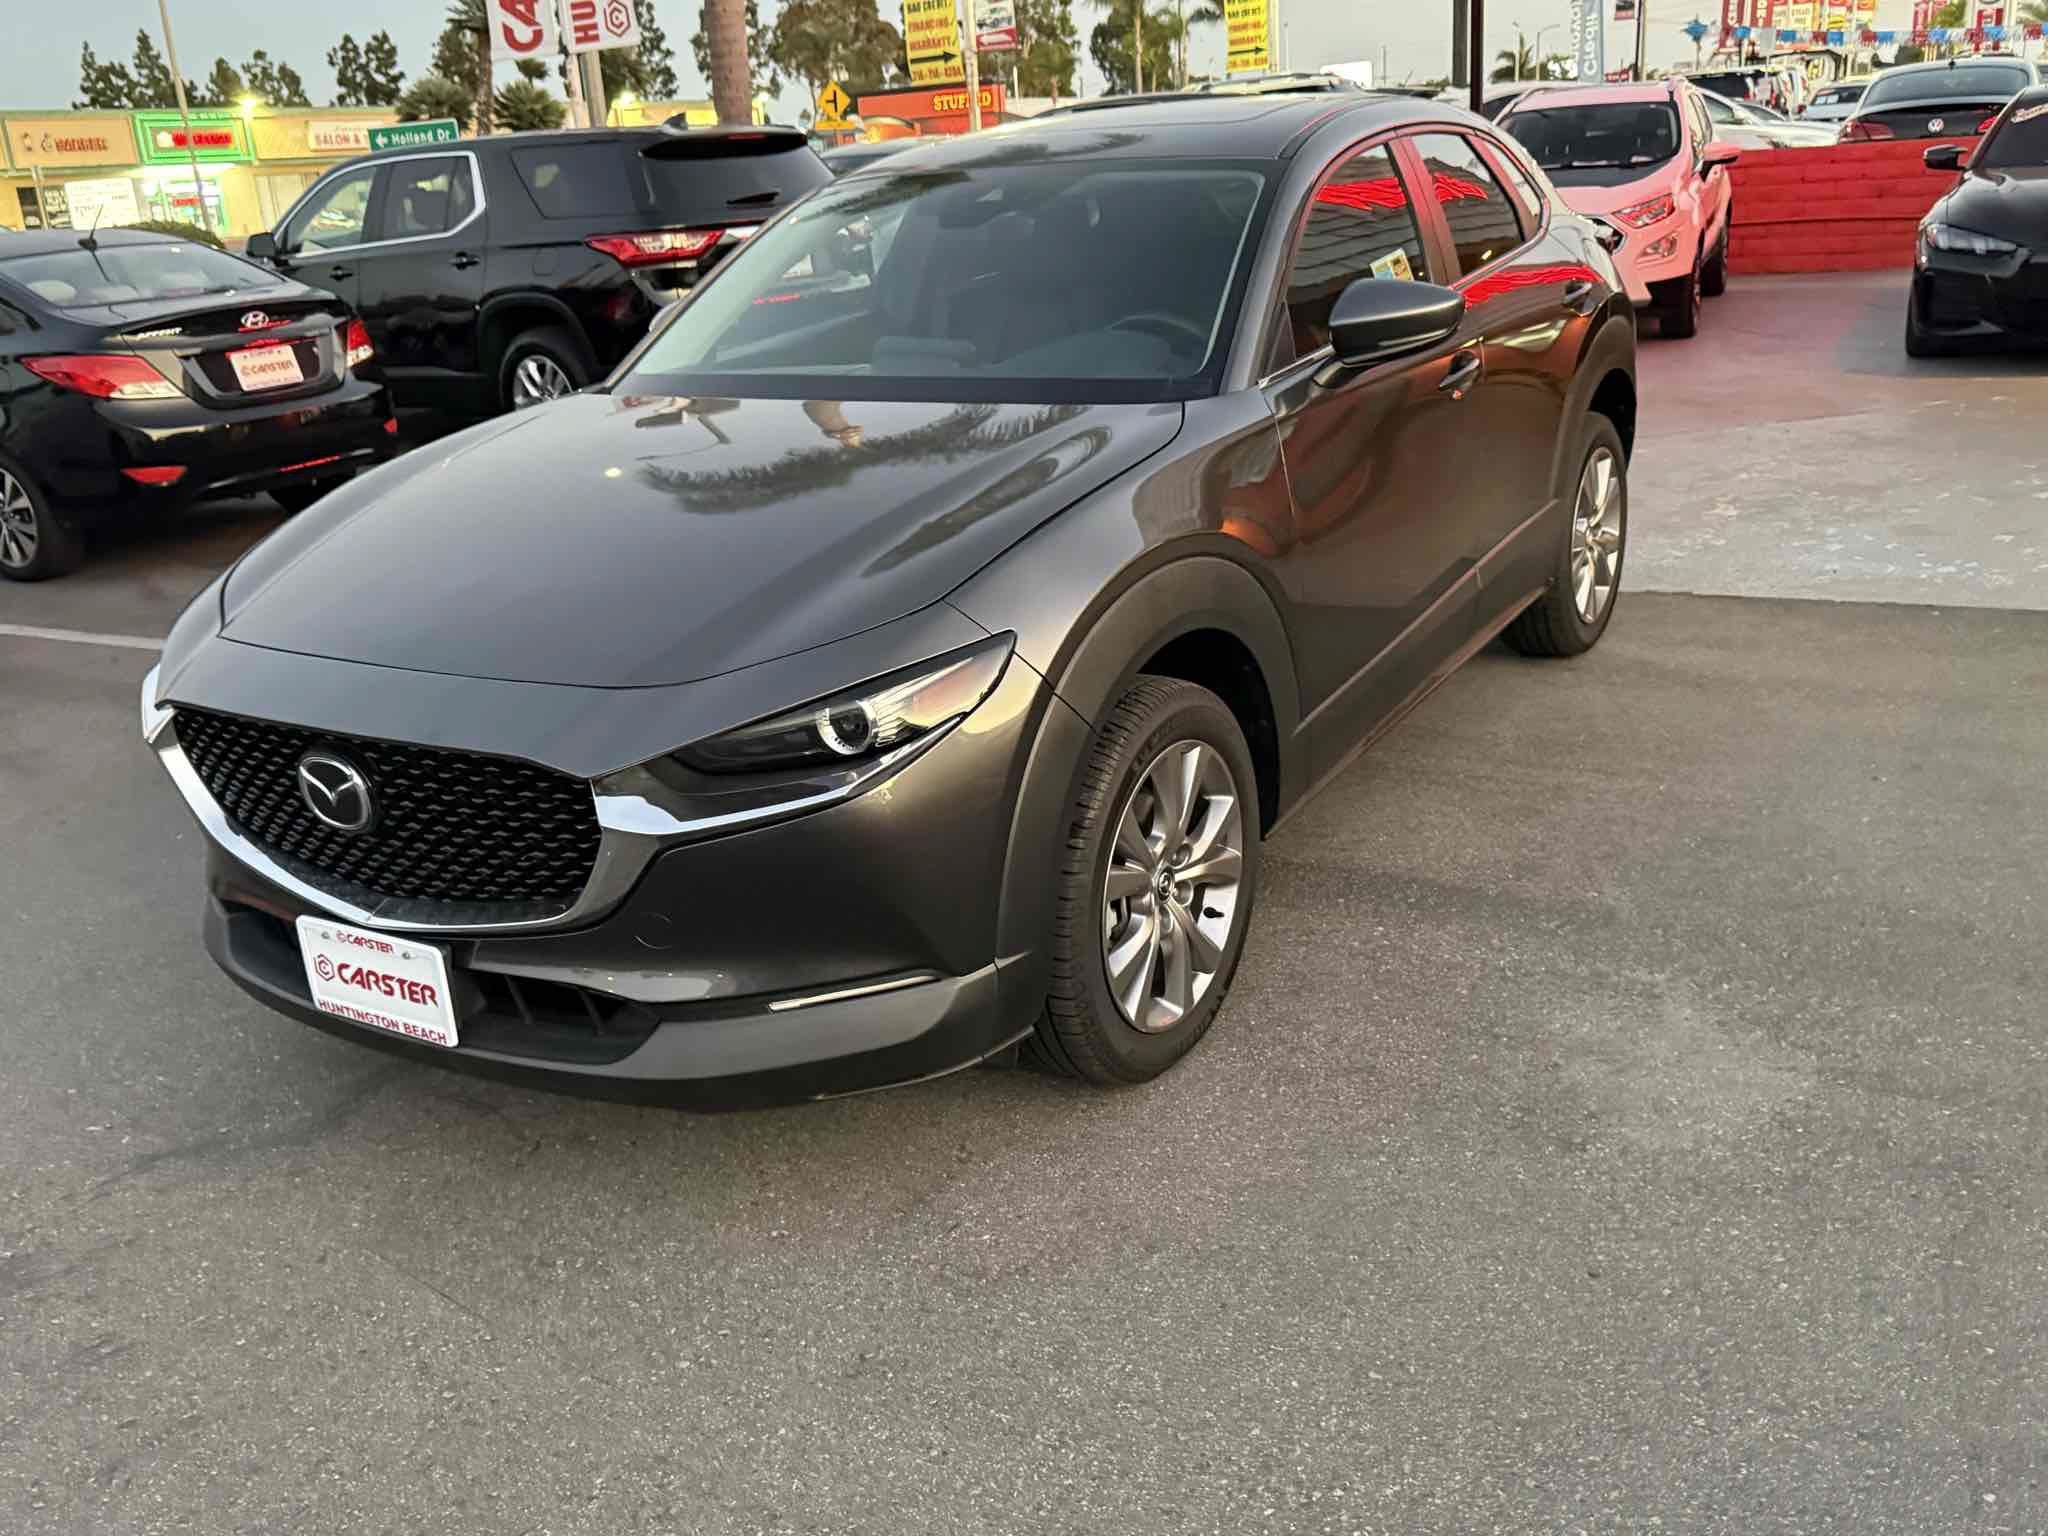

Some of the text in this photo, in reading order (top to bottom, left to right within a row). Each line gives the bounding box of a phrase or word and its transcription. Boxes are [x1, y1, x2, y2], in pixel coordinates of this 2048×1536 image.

[933, 91, 992, 112] STUFD
[391, 128, 452, 146] Holland Dr
[347, 934, 394, 954] CARSTER
[337, 963, 439, 1008] CARSTER
[318, 998, 448, 1045] HUNTINGTON BEACH
